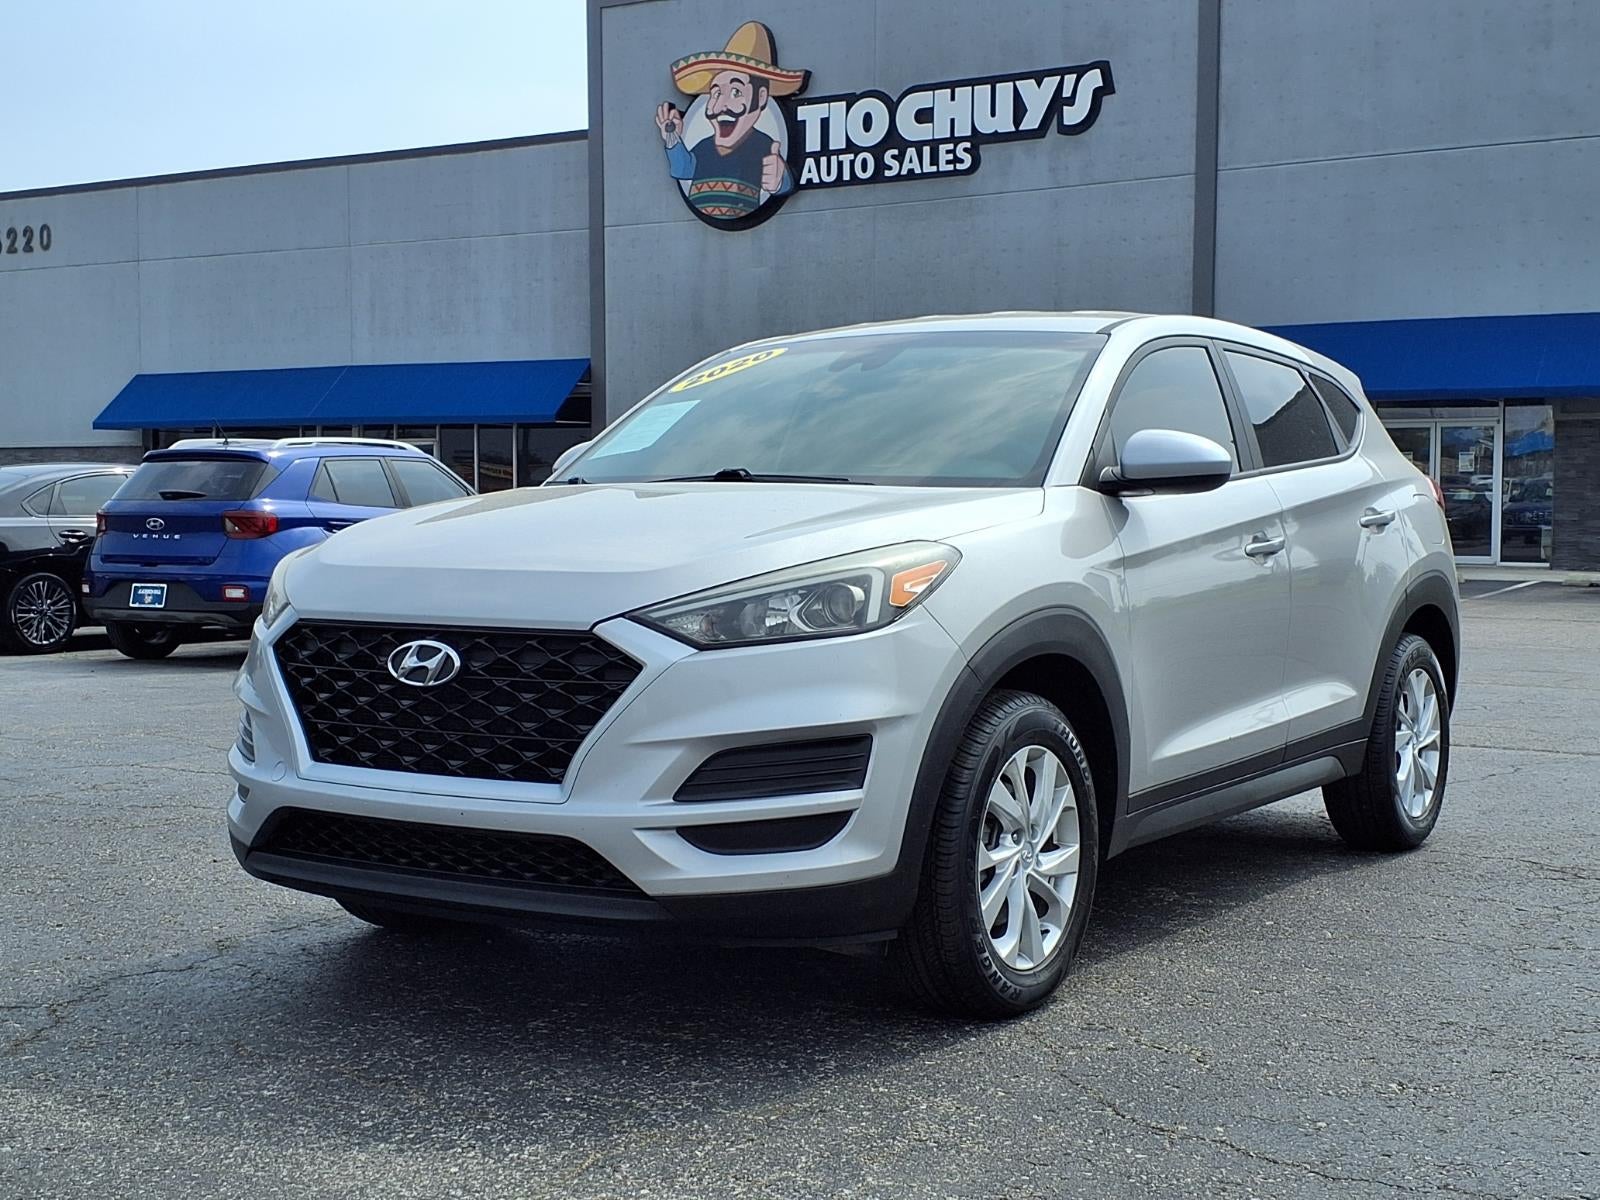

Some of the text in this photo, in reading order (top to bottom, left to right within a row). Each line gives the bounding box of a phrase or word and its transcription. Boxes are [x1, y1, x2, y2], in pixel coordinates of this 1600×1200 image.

[797, 68, 1104, 153] TIO CHUY'S
[799, 141, 972, 185] AUTO SALES
[0, 223, 52, 254] 220
[682, 351, 775, 389] 2020
